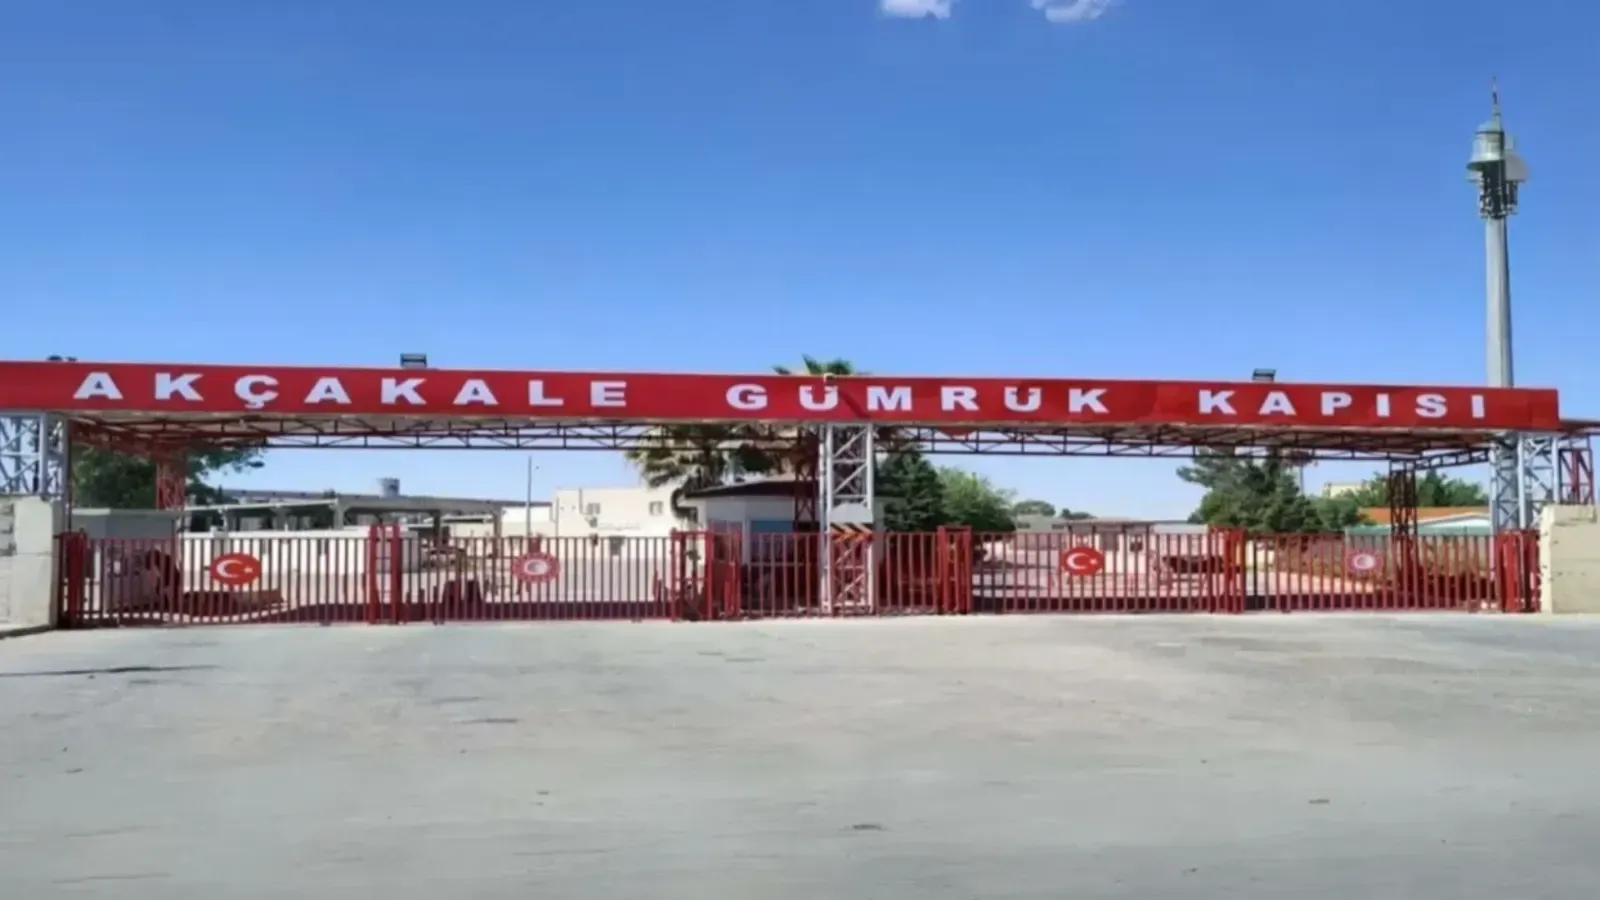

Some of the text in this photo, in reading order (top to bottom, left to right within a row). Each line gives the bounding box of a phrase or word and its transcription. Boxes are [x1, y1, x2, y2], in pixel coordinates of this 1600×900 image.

[74, 372, 1488, 419] AKÇAKALE GÜMRÜK KAPISI
